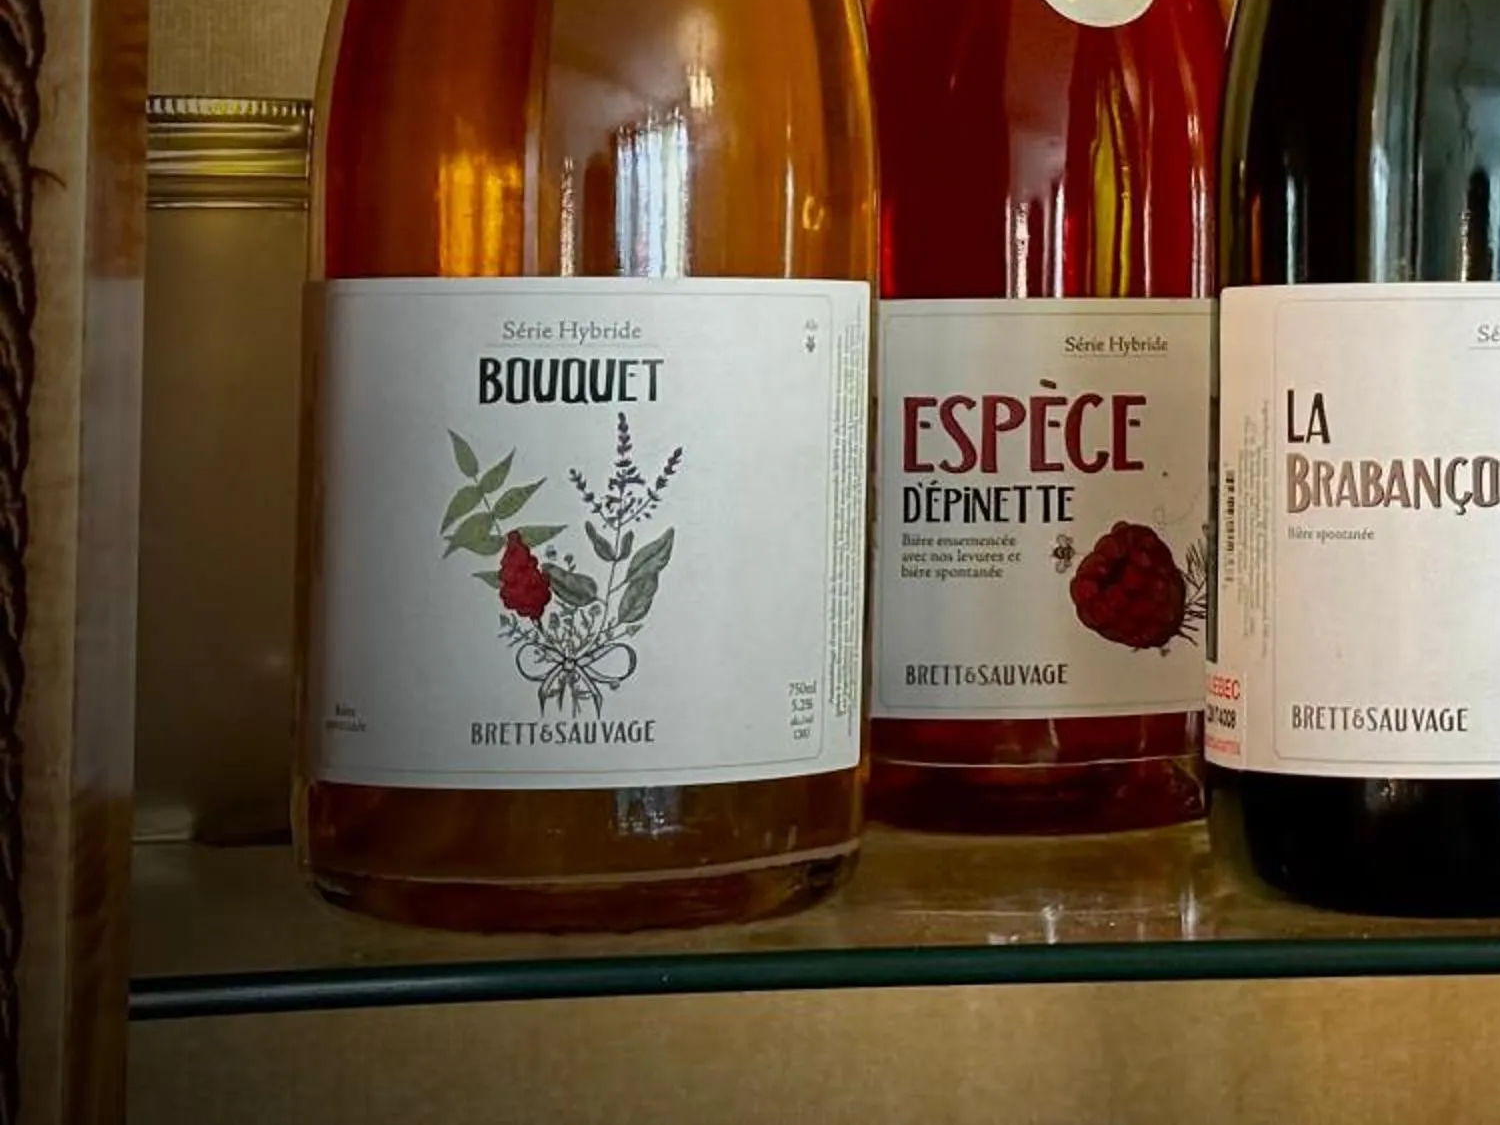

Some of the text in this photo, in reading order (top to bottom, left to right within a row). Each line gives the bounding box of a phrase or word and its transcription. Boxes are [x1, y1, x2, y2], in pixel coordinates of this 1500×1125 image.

[502, 320, 642, 345] Série Hybride
[1064, 336, 1168, 356] Série Hybride
[479, 357, 665, 404] BOUQUET
[903, 378, 1147, 474] ESPÈCE
[1287, 388, 1331, 444] LA
